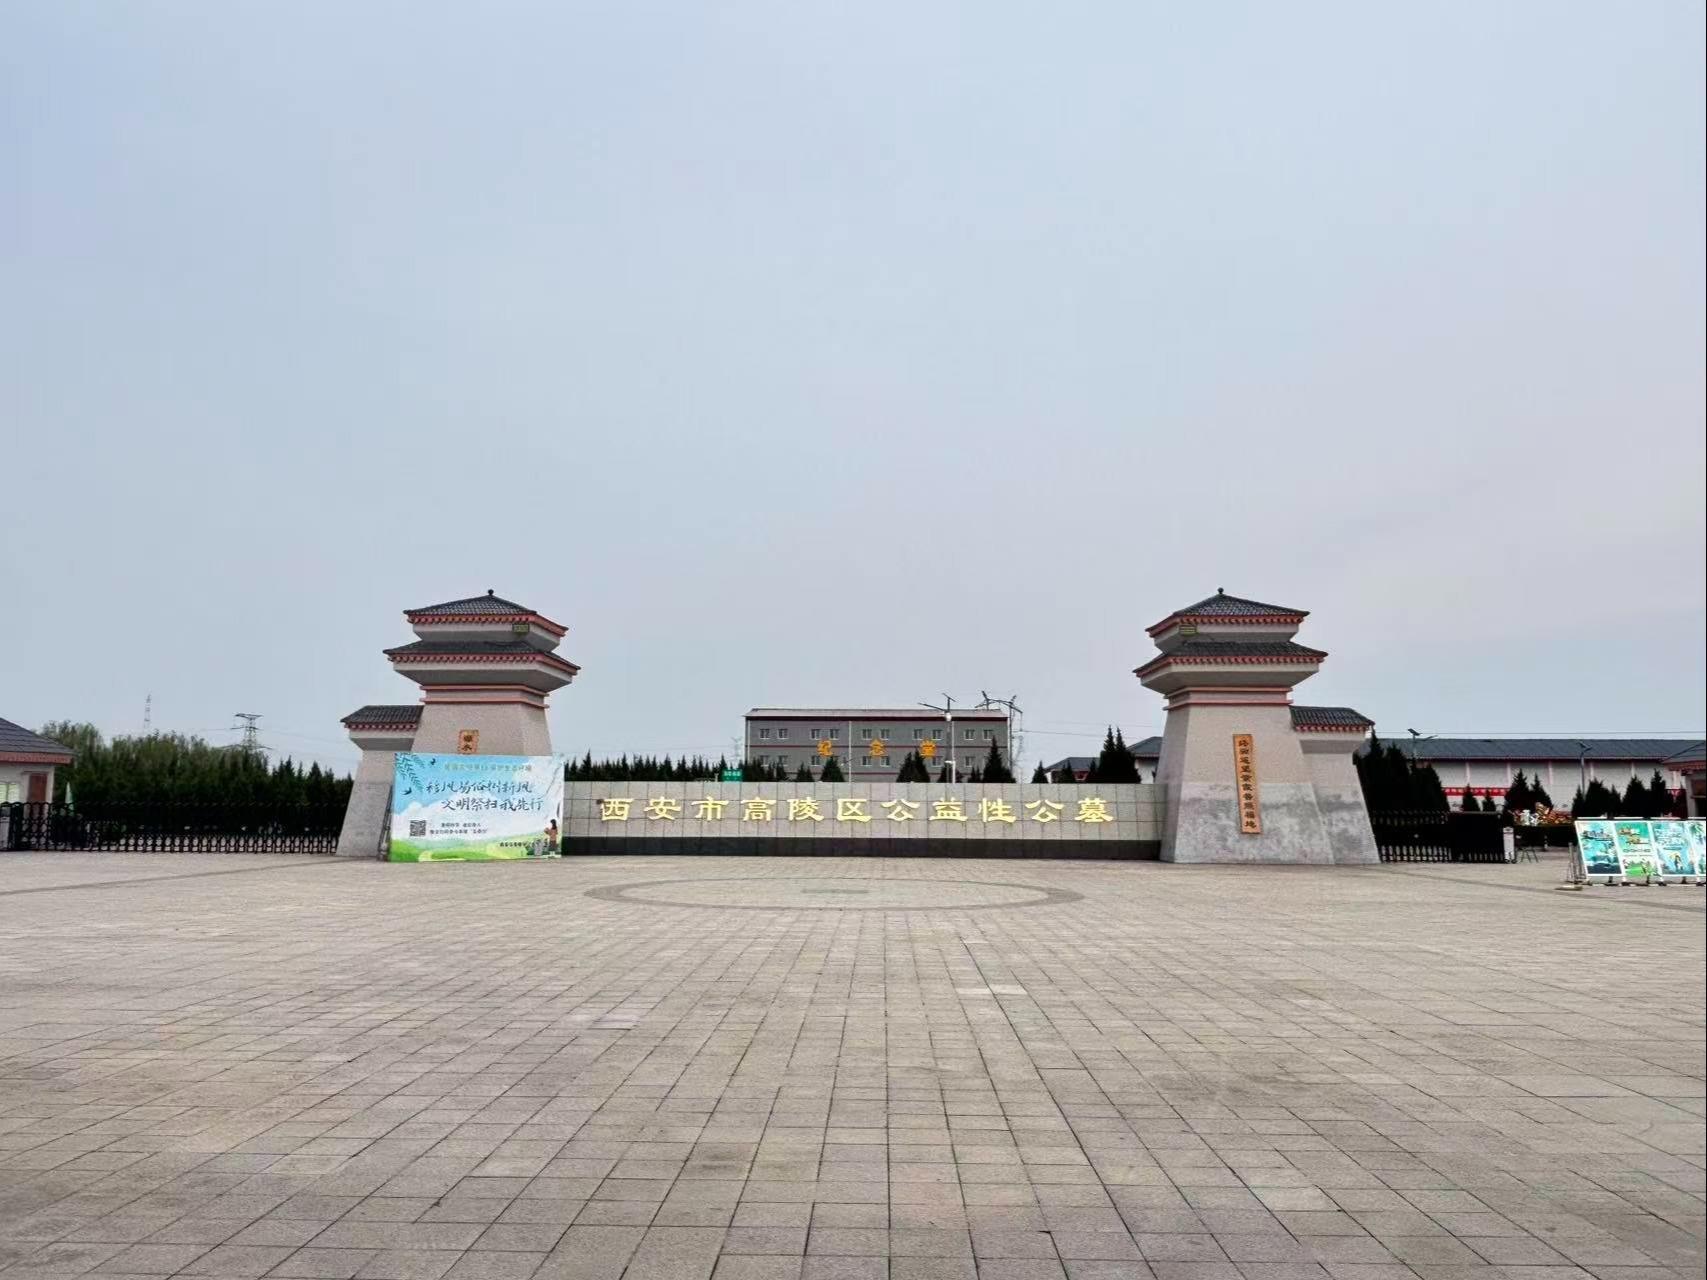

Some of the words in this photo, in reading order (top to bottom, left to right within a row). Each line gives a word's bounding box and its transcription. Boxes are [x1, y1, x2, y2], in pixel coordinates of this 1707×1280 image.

[817, 739, 937, 758] 纪念堂
[426, 780, 533, 794] 移风易俗树新风
[441, 797, 543, 812] 文明祭扫我先行
[600, 797, 1114, 823] 西安市高陵区公益性公墓
